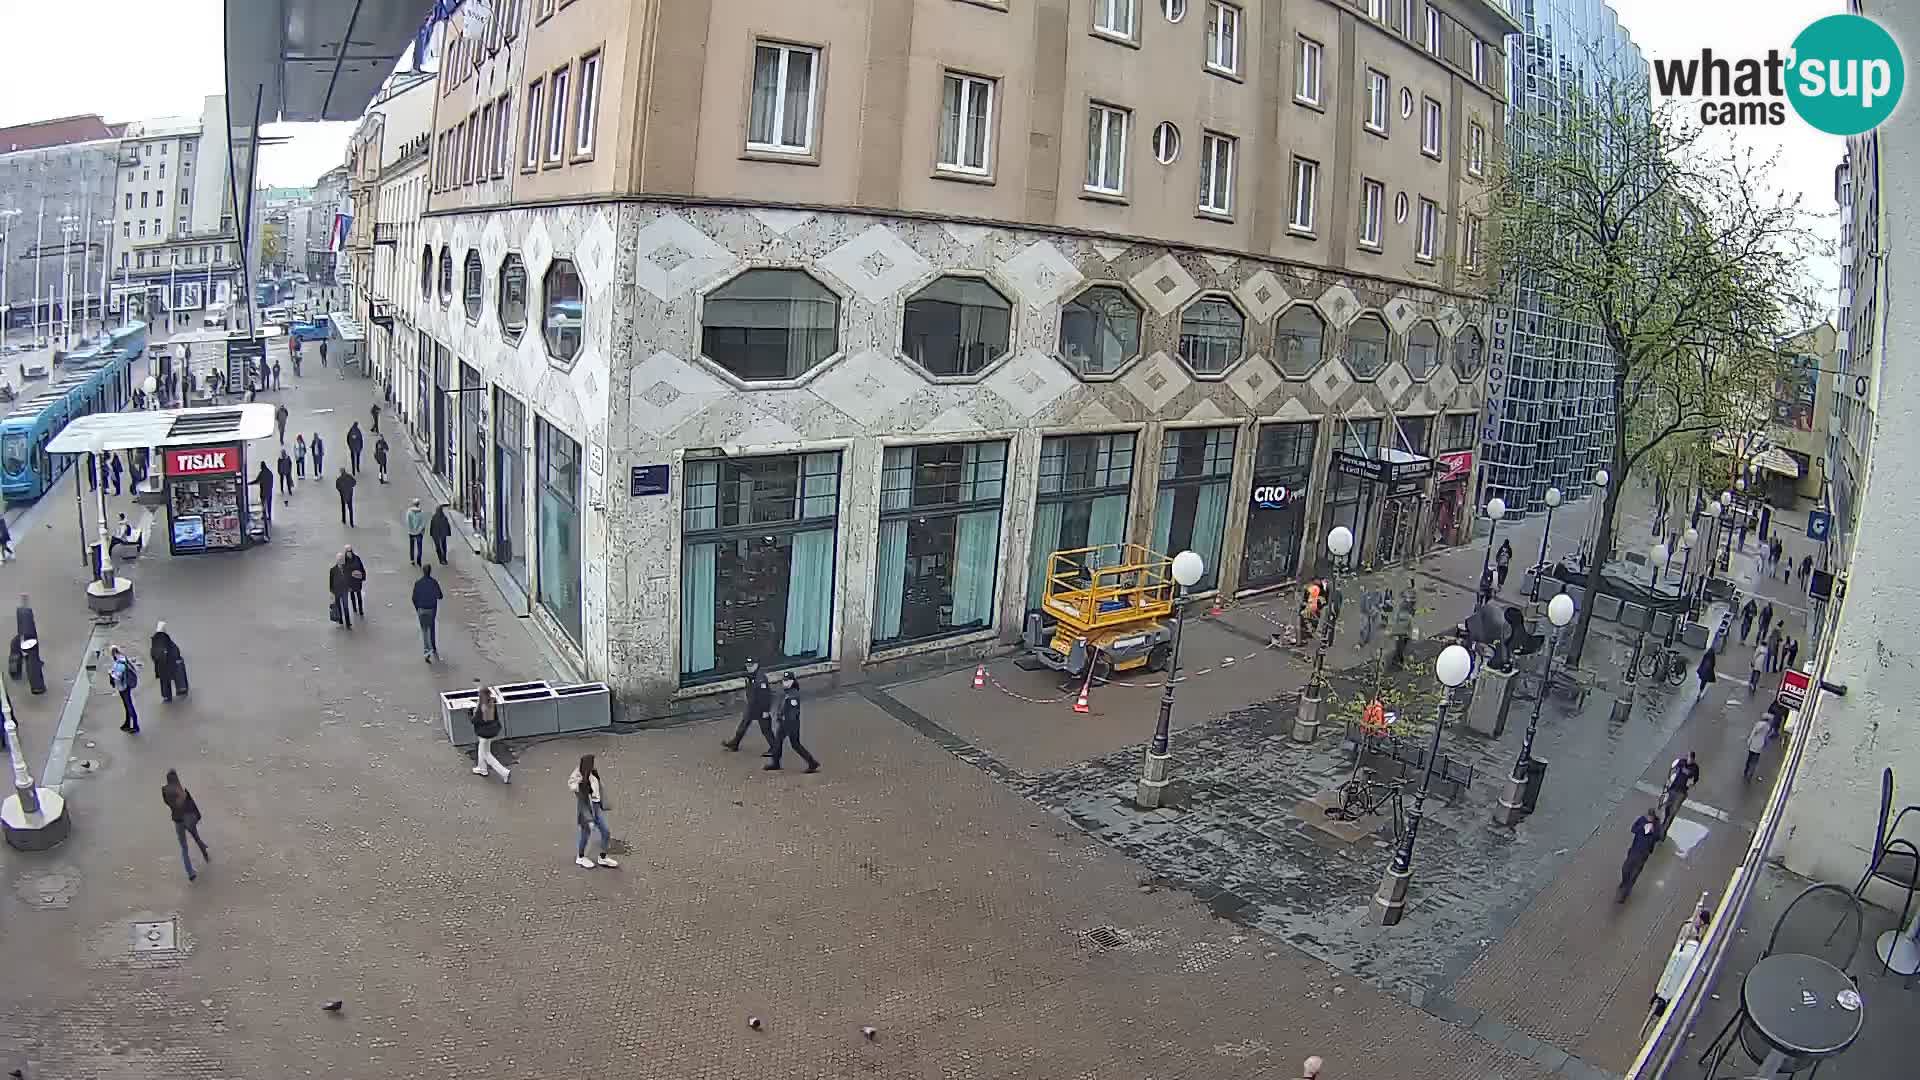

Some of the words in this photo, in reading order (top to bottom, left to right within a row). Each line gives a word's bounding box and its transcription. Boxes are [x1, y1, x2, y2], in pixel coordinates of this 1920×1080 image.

[1482, 307, 1509, 440] DUBROVNIK
[177, 452, 226, 471] TISAK
[1254, 486, 1286, 502] CRO
